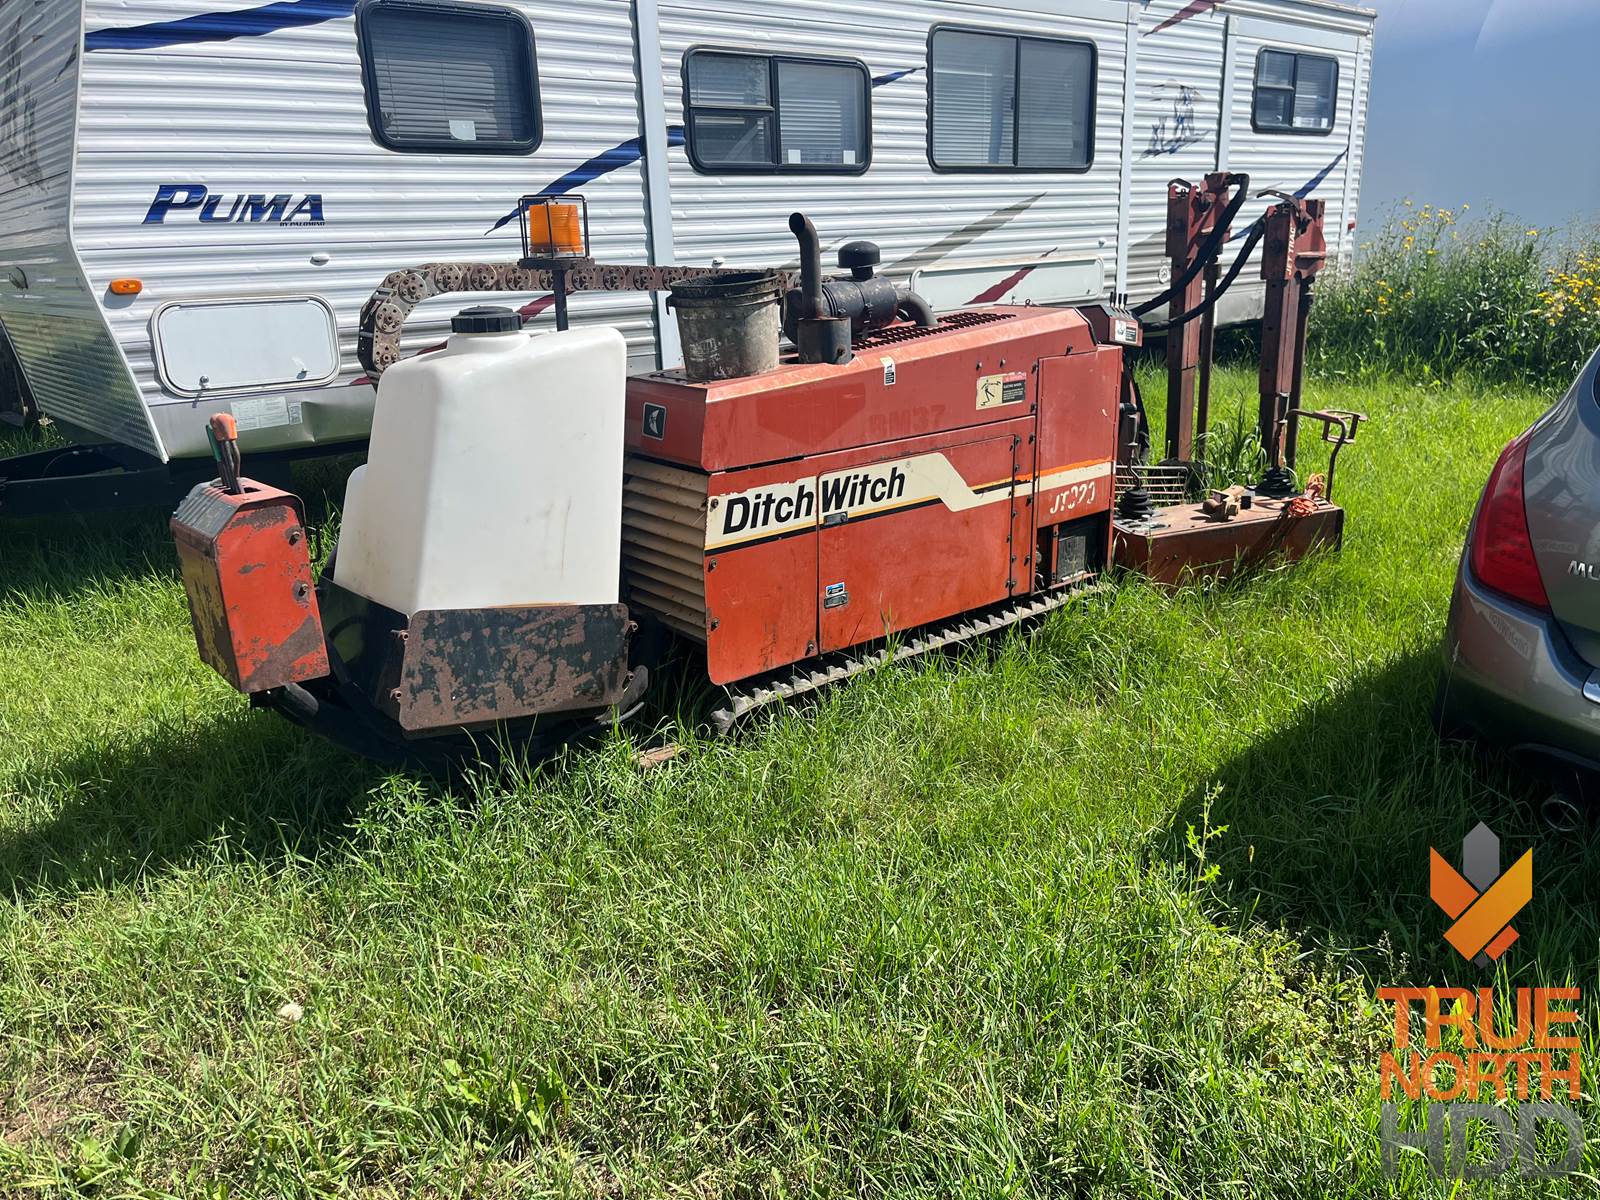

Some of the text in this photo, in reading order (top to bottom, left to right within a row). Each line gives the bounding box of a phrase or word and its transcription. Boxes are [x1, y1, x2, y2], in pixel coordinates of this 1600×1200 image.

[141, 184, 325, 225] PUMA
[1288, 226, 1296, 254] TRAC
[723, 467, 906, 535] Ditch Witch
